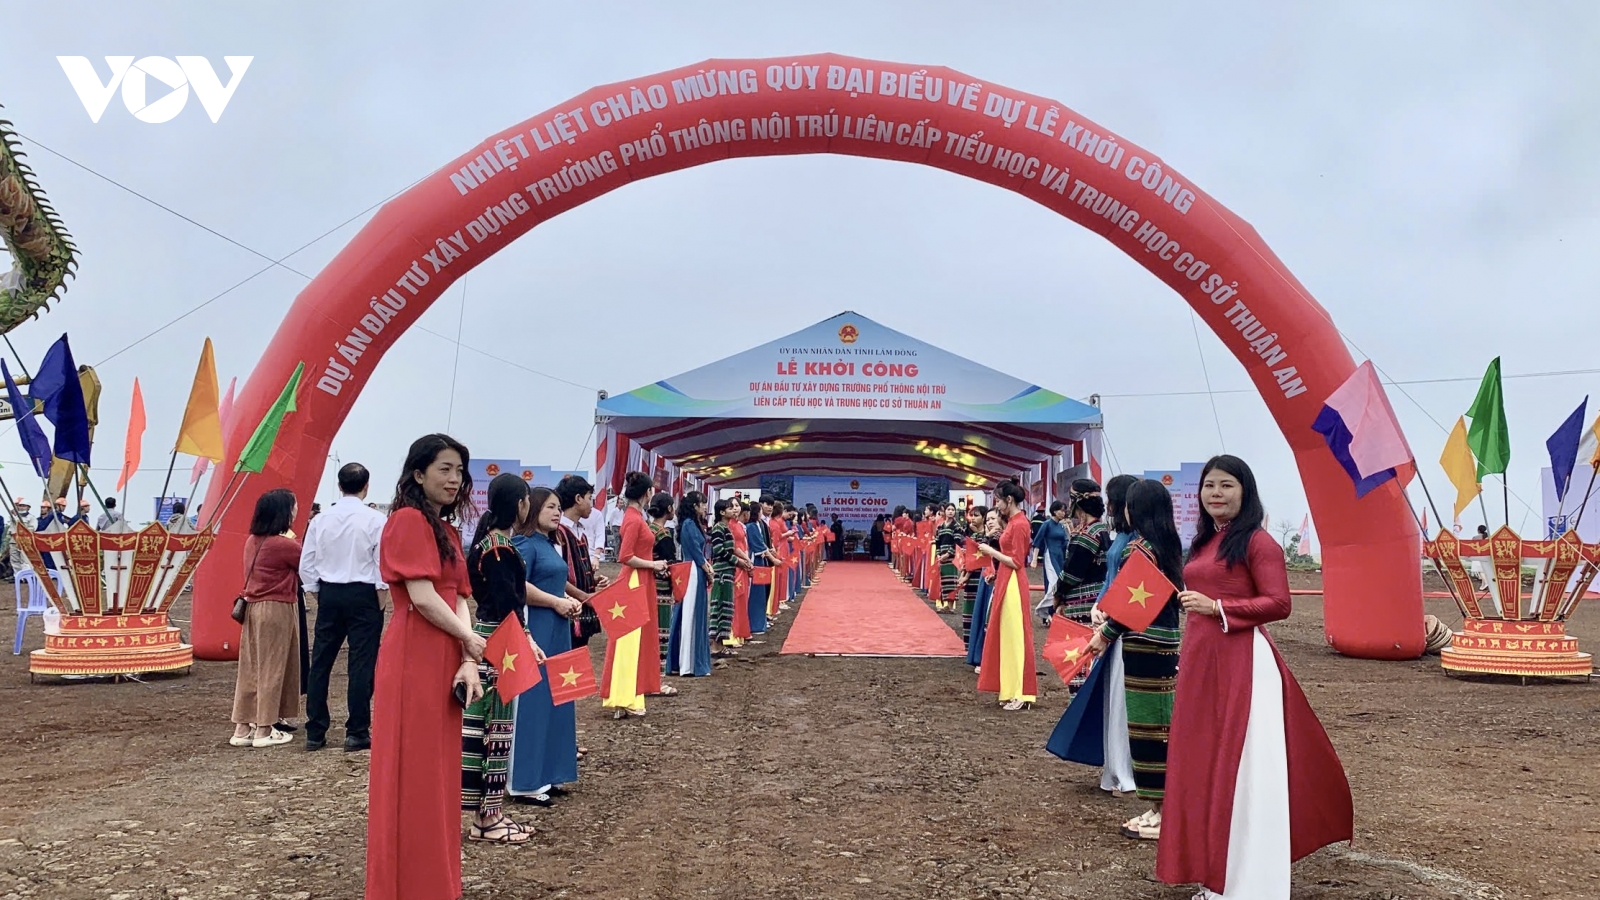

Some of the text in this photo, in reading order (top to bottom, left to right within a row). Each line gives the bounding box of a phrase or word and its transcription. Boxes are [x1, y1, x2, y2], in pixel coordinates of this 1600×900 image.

[449, 62, 1196, 215] NHIỆT LIỆT CHÀO MỪNG QÚY ĐẠI BIỂU VỀ DỰ LỄ KHỞI CÔNG
[316, 108, 1308, 399] DỰ ÁN ĐẦU TƯ XÂY DỰNG TRƯỜNG PHỔ THÔNG NỘI TRÚ LIÊN CẤP TIỂU HỌC VÀ TRUNG HỌC CƠ SỞ THUẬN AN
[777, 357, 919, 377] LỄ KHỞI CÔNG
[750, 380, 946, 396] DỰ ÁN ĐẦU TƯ XÂY DỰNG TRƯỜNG PHỔ THÔNG NỘI TRÚ
[754, 394, 941, 410] LIÊN CẤP TIỂU HỌC VÀ TRUNG HỌC CƠ SỞ THUẬN AN
